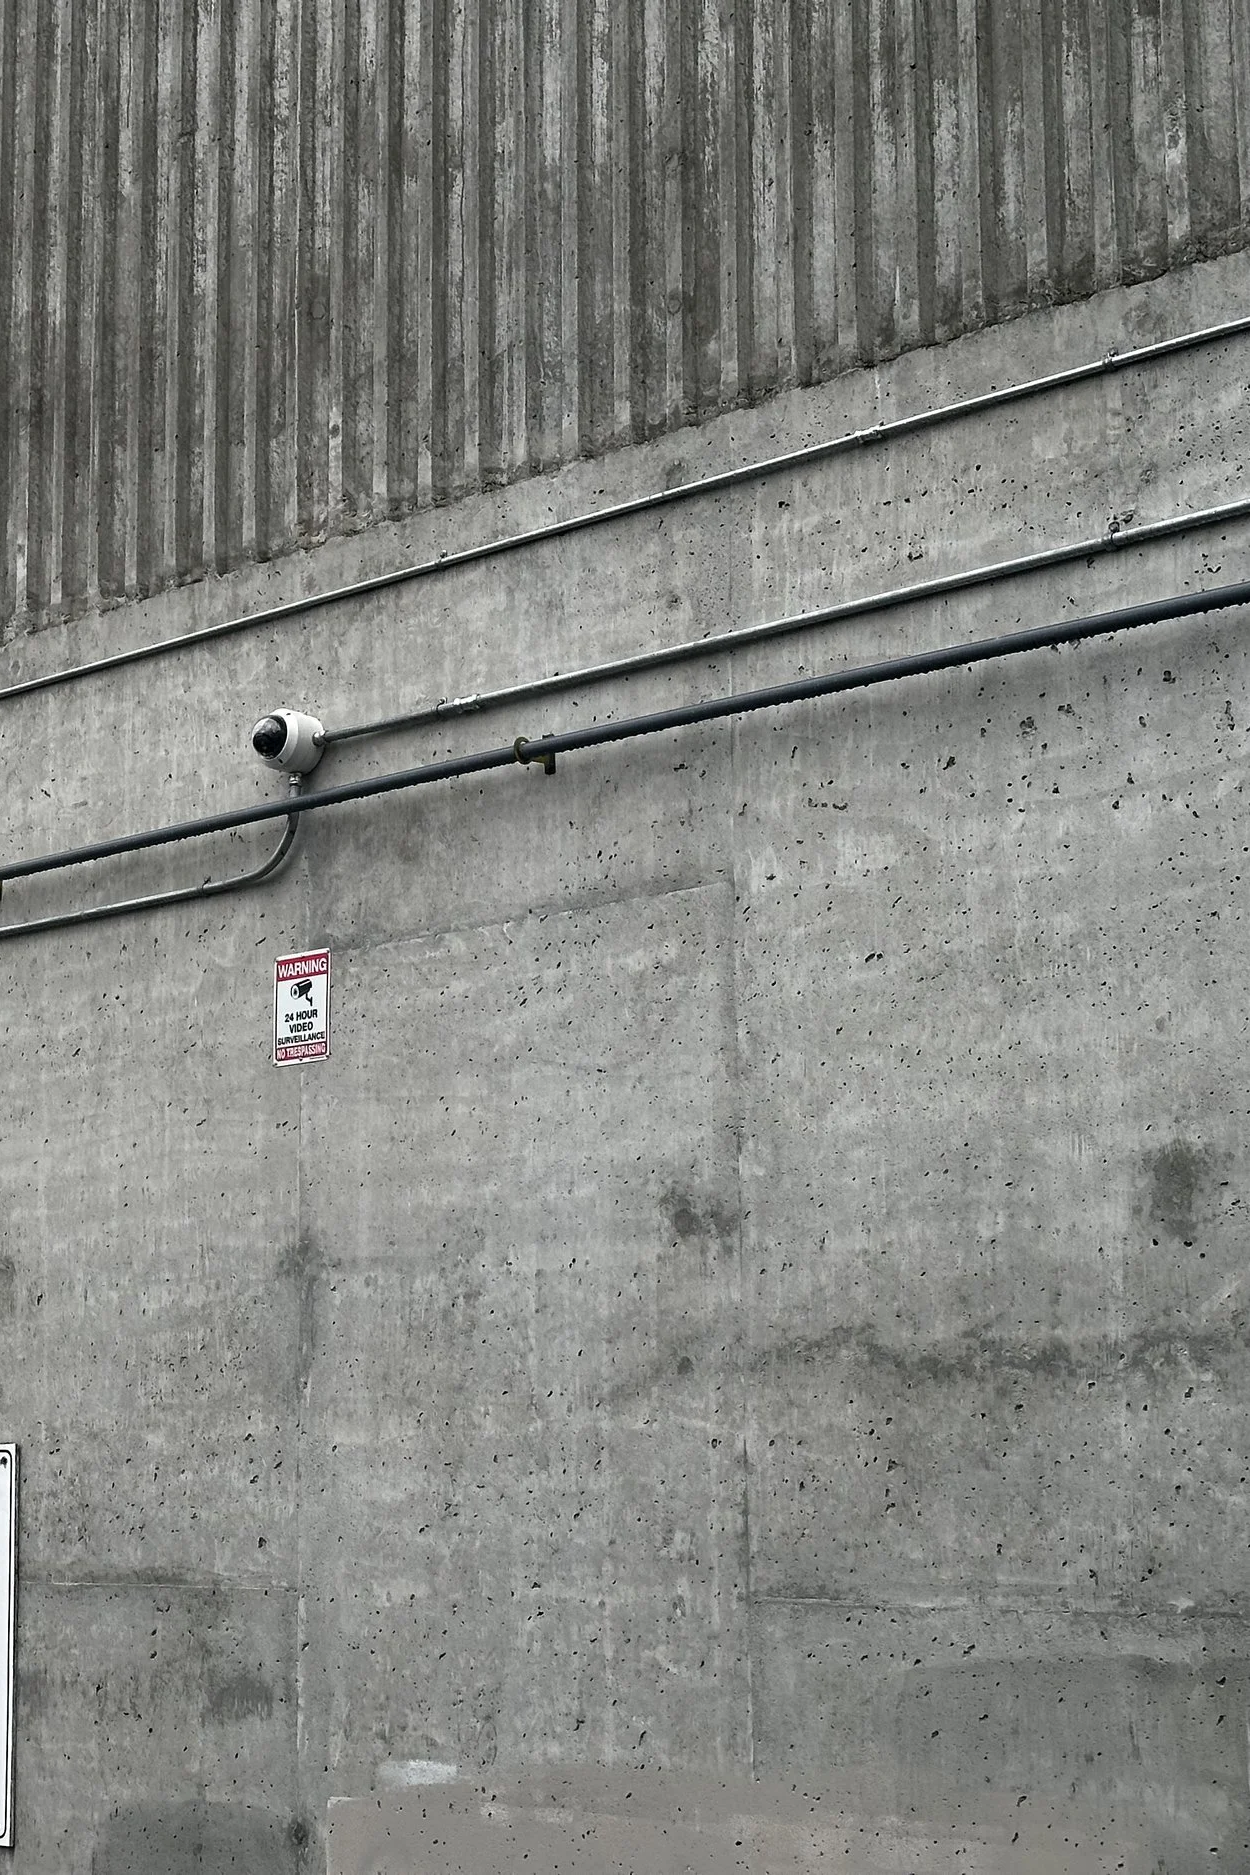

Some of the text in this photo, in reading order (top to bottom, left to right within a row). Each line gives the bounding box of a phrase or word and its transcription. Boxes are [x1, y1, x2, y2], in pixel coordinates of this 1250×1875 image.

[278, 957, 327, 978] WARNING
[284, 1009, 318, 1023] 24 HOUR
[289, 1021, 313, 1033] VIDEO
[278, 1031, 325, 1045] SURVEILLANCE
[277, 1043, 326, 1059] NO TRESPASSING
